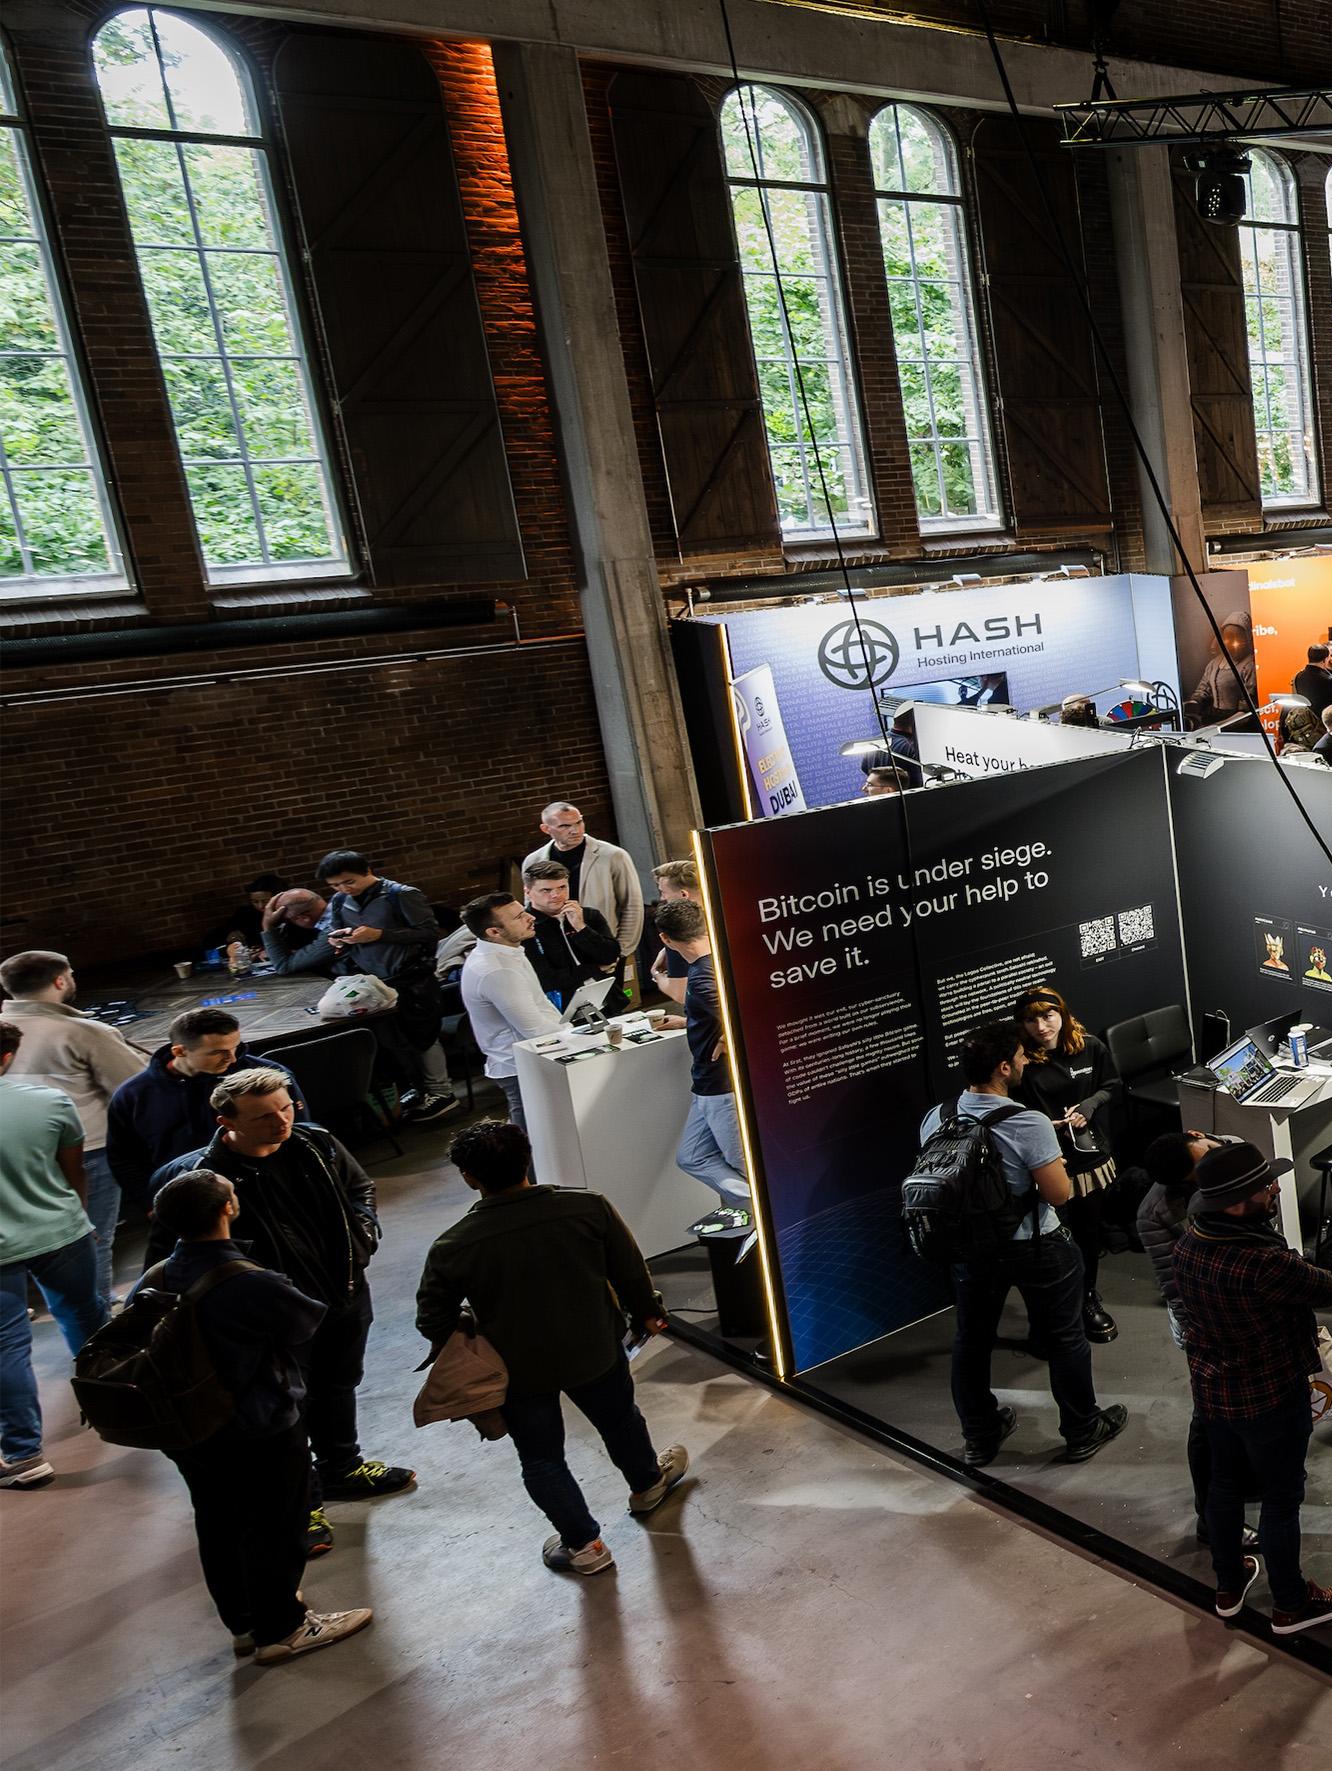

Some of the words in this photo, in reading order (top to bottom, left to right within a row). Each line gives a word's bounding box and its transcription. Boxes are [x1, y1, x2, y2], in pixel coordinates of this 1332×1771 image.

[914, 613, 1042, 650] HASH
[917, 653, 967, 668] Hosting
[970, 642, 1044, 662] International
[945, 746, 979, 765] Heat
[983, 756, 1015, 774] your
[769, 780, 798, 815] DUBAI
[758, 882, 860, 923] Bitcoin
[867, 876, 890, 898] is
[897, 856, 974, 891] under
[981, 839, 1053, 874] siege.
[762, 927, 814, 955] We
[822, 904, 893, 943] need
[900, 891, 959, 929] your
[965, 876, 1018, 910] help
[1026, 870, 1049, 889] to
[769, 955, 838, 990] save
[845, 946, 871, 969] it.
